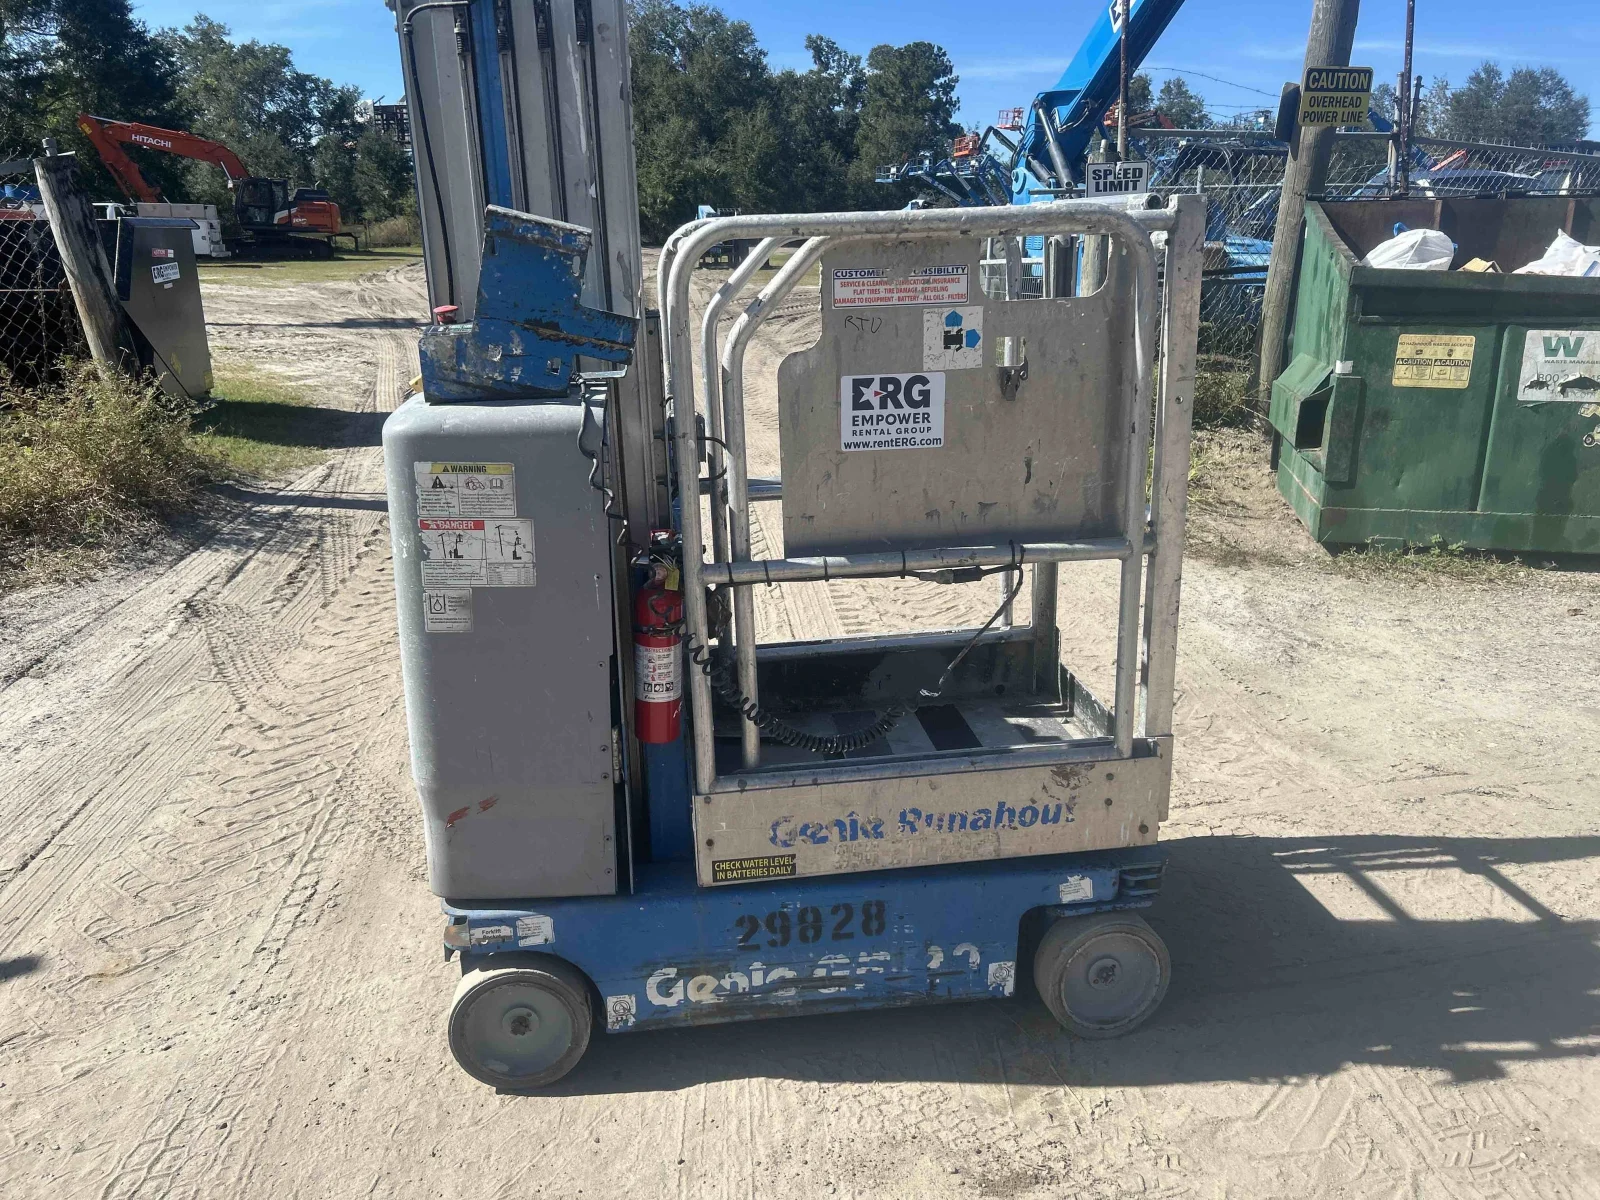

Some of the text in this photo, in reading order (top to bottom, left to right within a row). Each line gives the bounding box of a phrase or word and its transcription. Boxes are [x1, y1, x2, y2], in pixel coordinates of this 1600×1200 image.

[1308, 72, 1369, 89] CAUTION
[1308, 96, 1362, 108] OVERHEAD
[1302, 111, 1364, 123] POWER LINE
[131, 133, 172, 148] HITACHI
[1092, 168, 1144, 181] SPEED
[1094, 180, 1140, 193] LIMIT
[835, 269, 884, 278] CUSTOME
[840, 280, 861, 288] SERVICE
[896, 286, 917, 294] DAMAGE
[921, 285, 949, 293] REFUELING
[835, 297, 857, 305] DAMAGE
[865, 296, 894, 304] EQUIPMENT
[934, 293, 945, 301] OILS
[948, 292, 967, 300] FILTERS
[1403, 358, 1432, 366] CAUTION
[852, 374, 931, 411] ERG
[852, 412, 931, 427] EMPOWER
[852, 427, 932, 437] RENTAL GROUP
[843, 437, 942, 449] www.rentERG.com
[450, 465, 487, 473] WARNING
[439, 520, 474, 529] DANGER
[714, 856, 794, 871] CHECK WATER LEVEL
[727, 868, 768, 879] BATTERIES
[770, 866, 792, 875] DAILY
[735, 900, 886, 950] 29828
